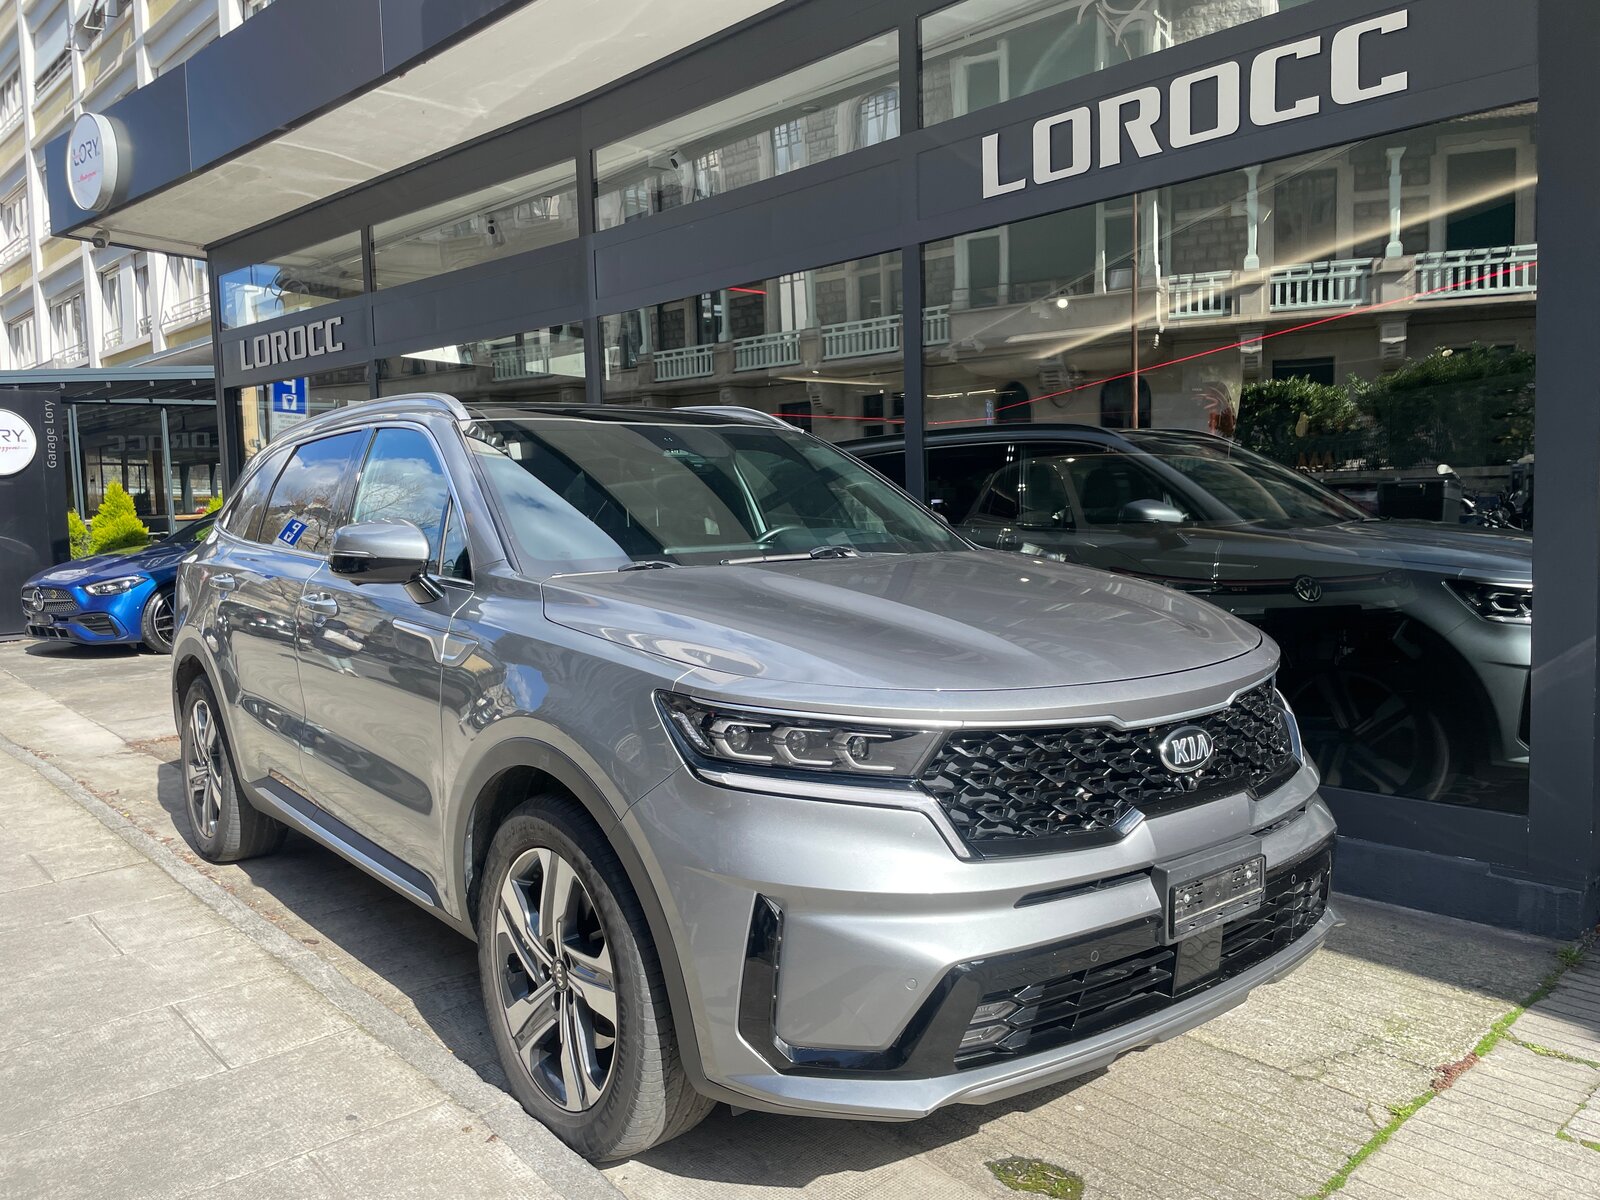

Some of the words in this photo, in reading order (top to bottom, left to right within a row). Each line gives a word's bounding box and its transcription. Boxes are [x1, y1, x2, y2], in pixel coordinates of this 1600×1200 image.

[981, 8, 1410, 199] LOROCC
[73, 136, 99, 167] LORY
[239, 316, 344, 371] LOROCC
[44, 400, 55, 424] Lory
[46, 427, 57, 468] Garage
[1171, 734, 1210, 764] KIA
